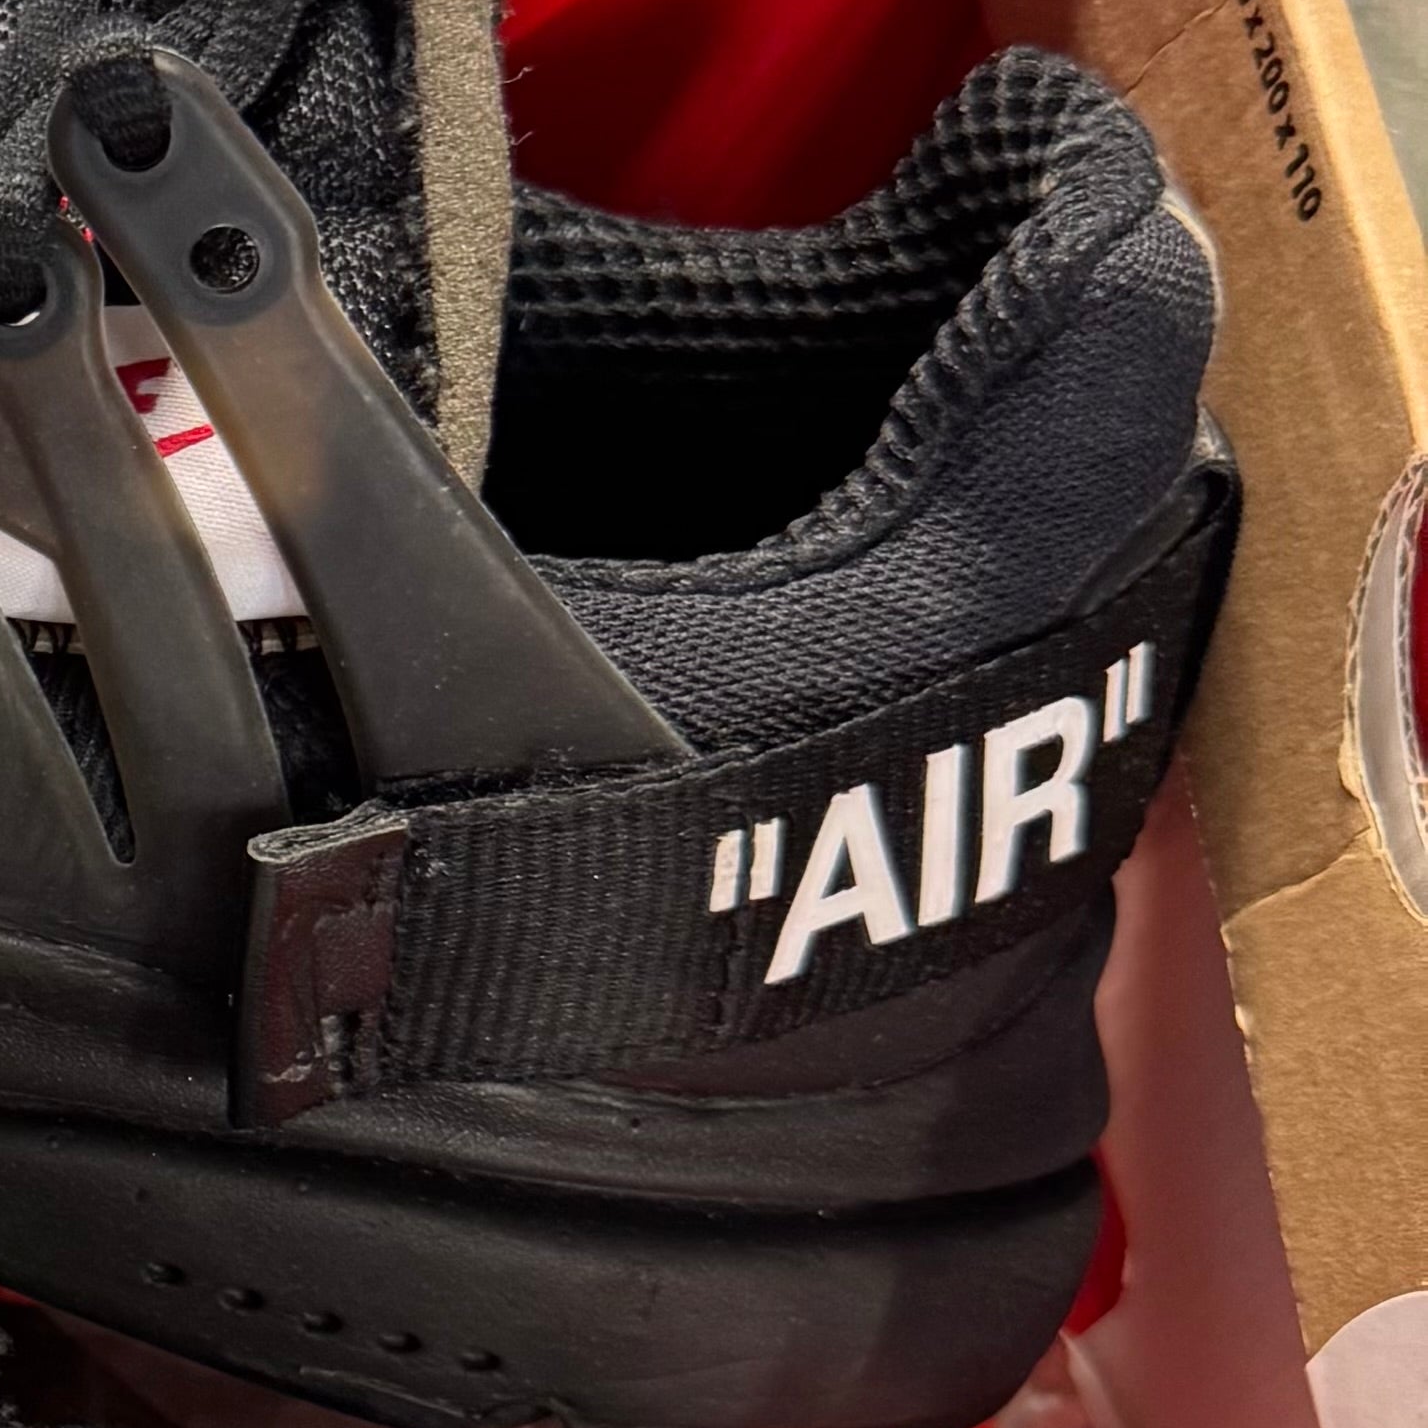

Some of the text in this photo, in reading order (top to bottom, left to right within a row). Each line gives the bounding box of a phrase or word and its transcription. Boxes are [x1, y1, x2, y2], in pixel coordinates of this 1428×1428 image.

[1253, 32, 1291, 115] 200
[1285, 142, 1323, 222] 110
[708, 641, 1153, 985] "AIR"
